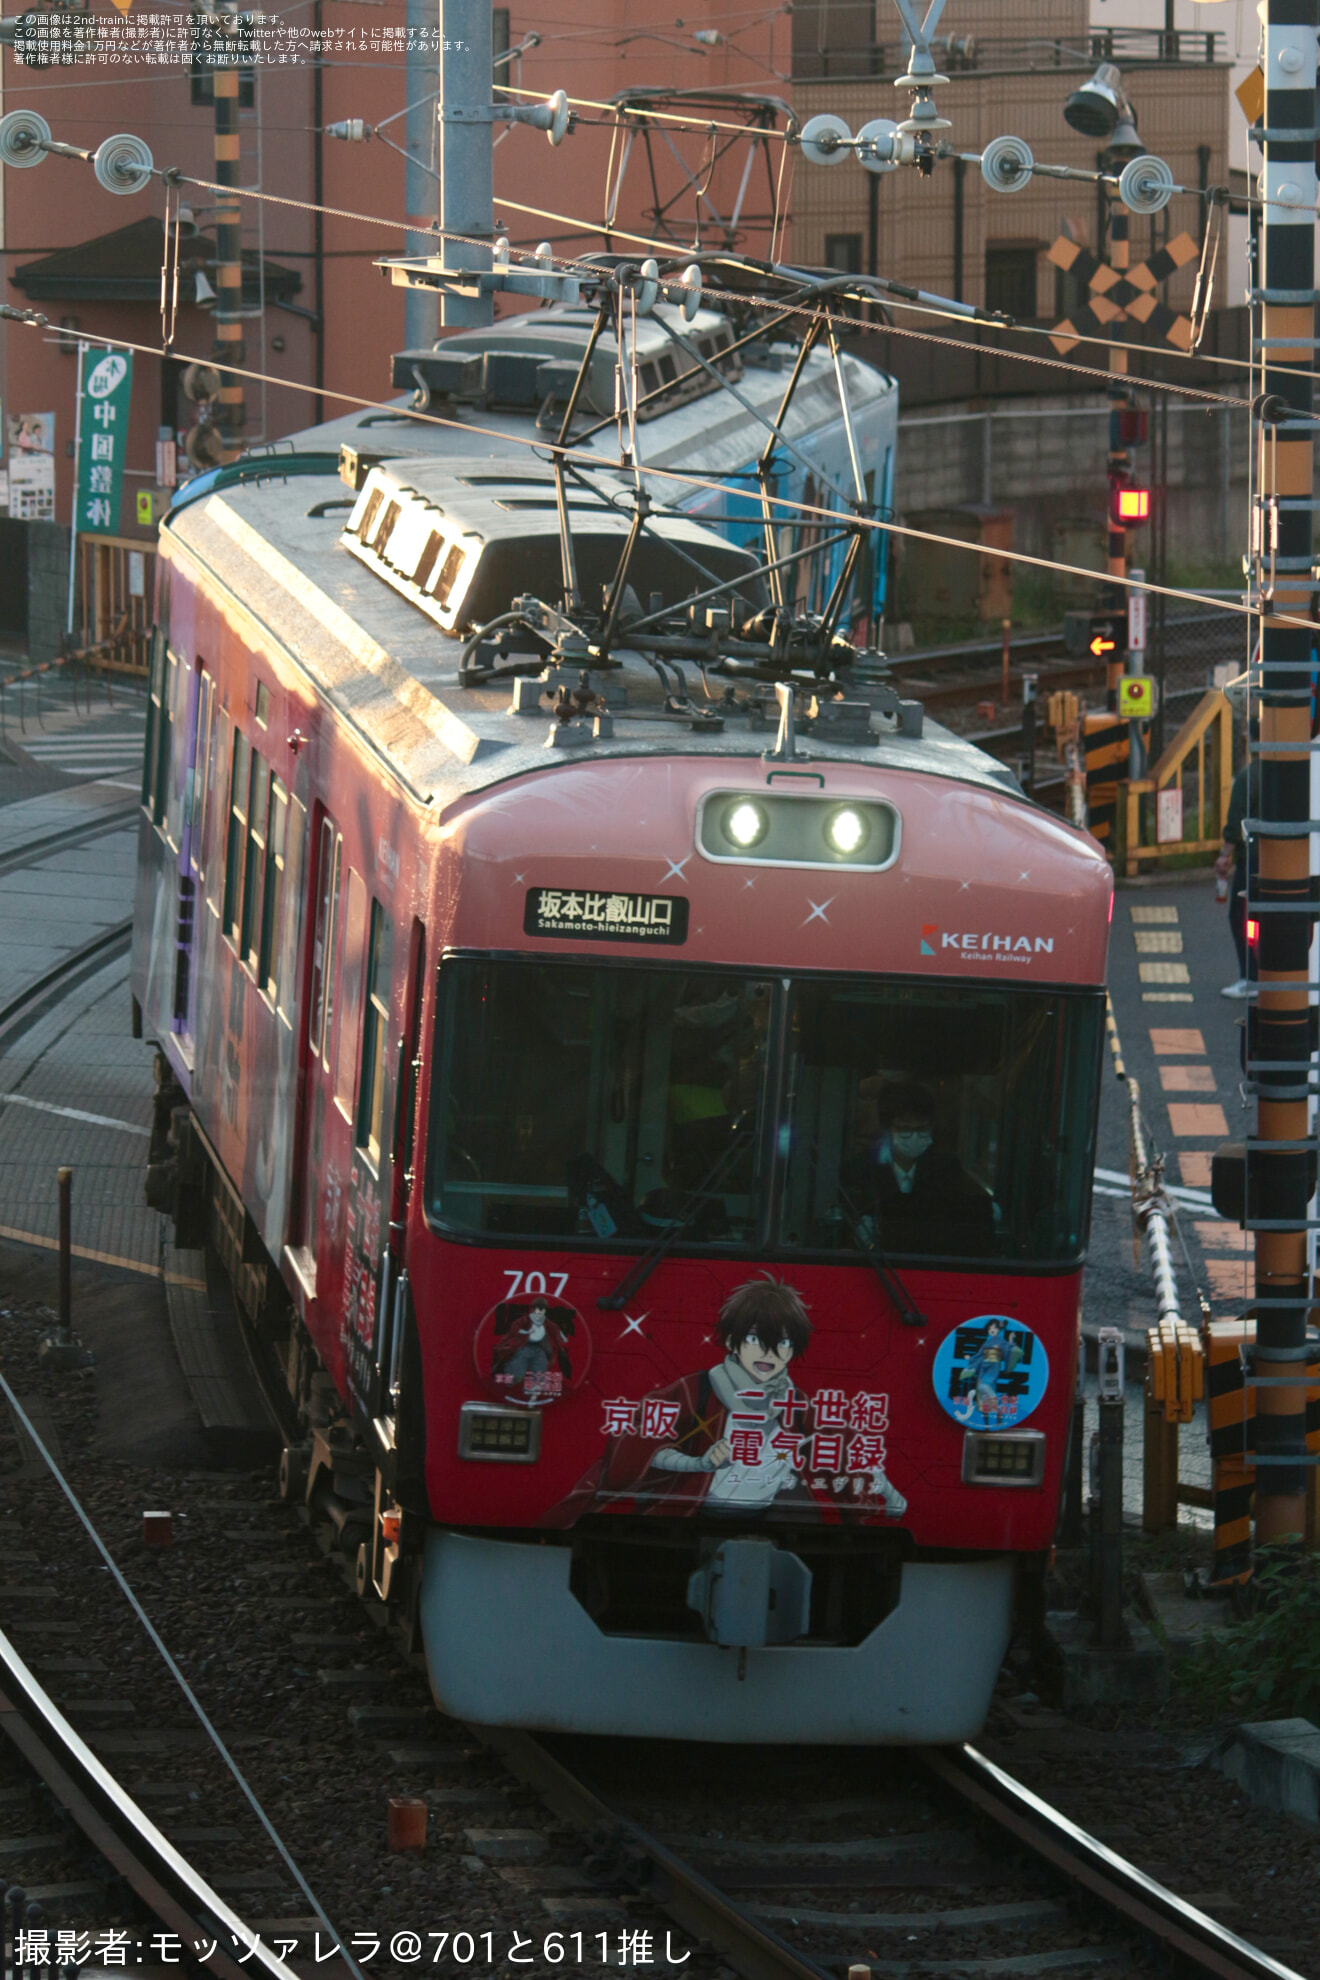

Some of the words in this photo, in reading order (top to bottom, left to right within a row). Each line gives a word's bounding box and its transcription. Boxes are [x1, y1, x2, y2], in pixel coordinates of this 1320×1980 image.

[537, 890, 673, 925] 坂本比叡山口
[538, 918, 670, 936] Sakamoto-hieizanguchi
[941, 932, 1054, 953] KEIHAN
[961, 952, 993, 961] Keihan
[995, 953, 1032, 964] Railway
[503, 1270, 570, 1301] 707
[601, 1396, 680, 1438] 京阪
[730, 1389, 889, 1432] 二十世紀
[728, 1429, 888, 1474] 電気目録
